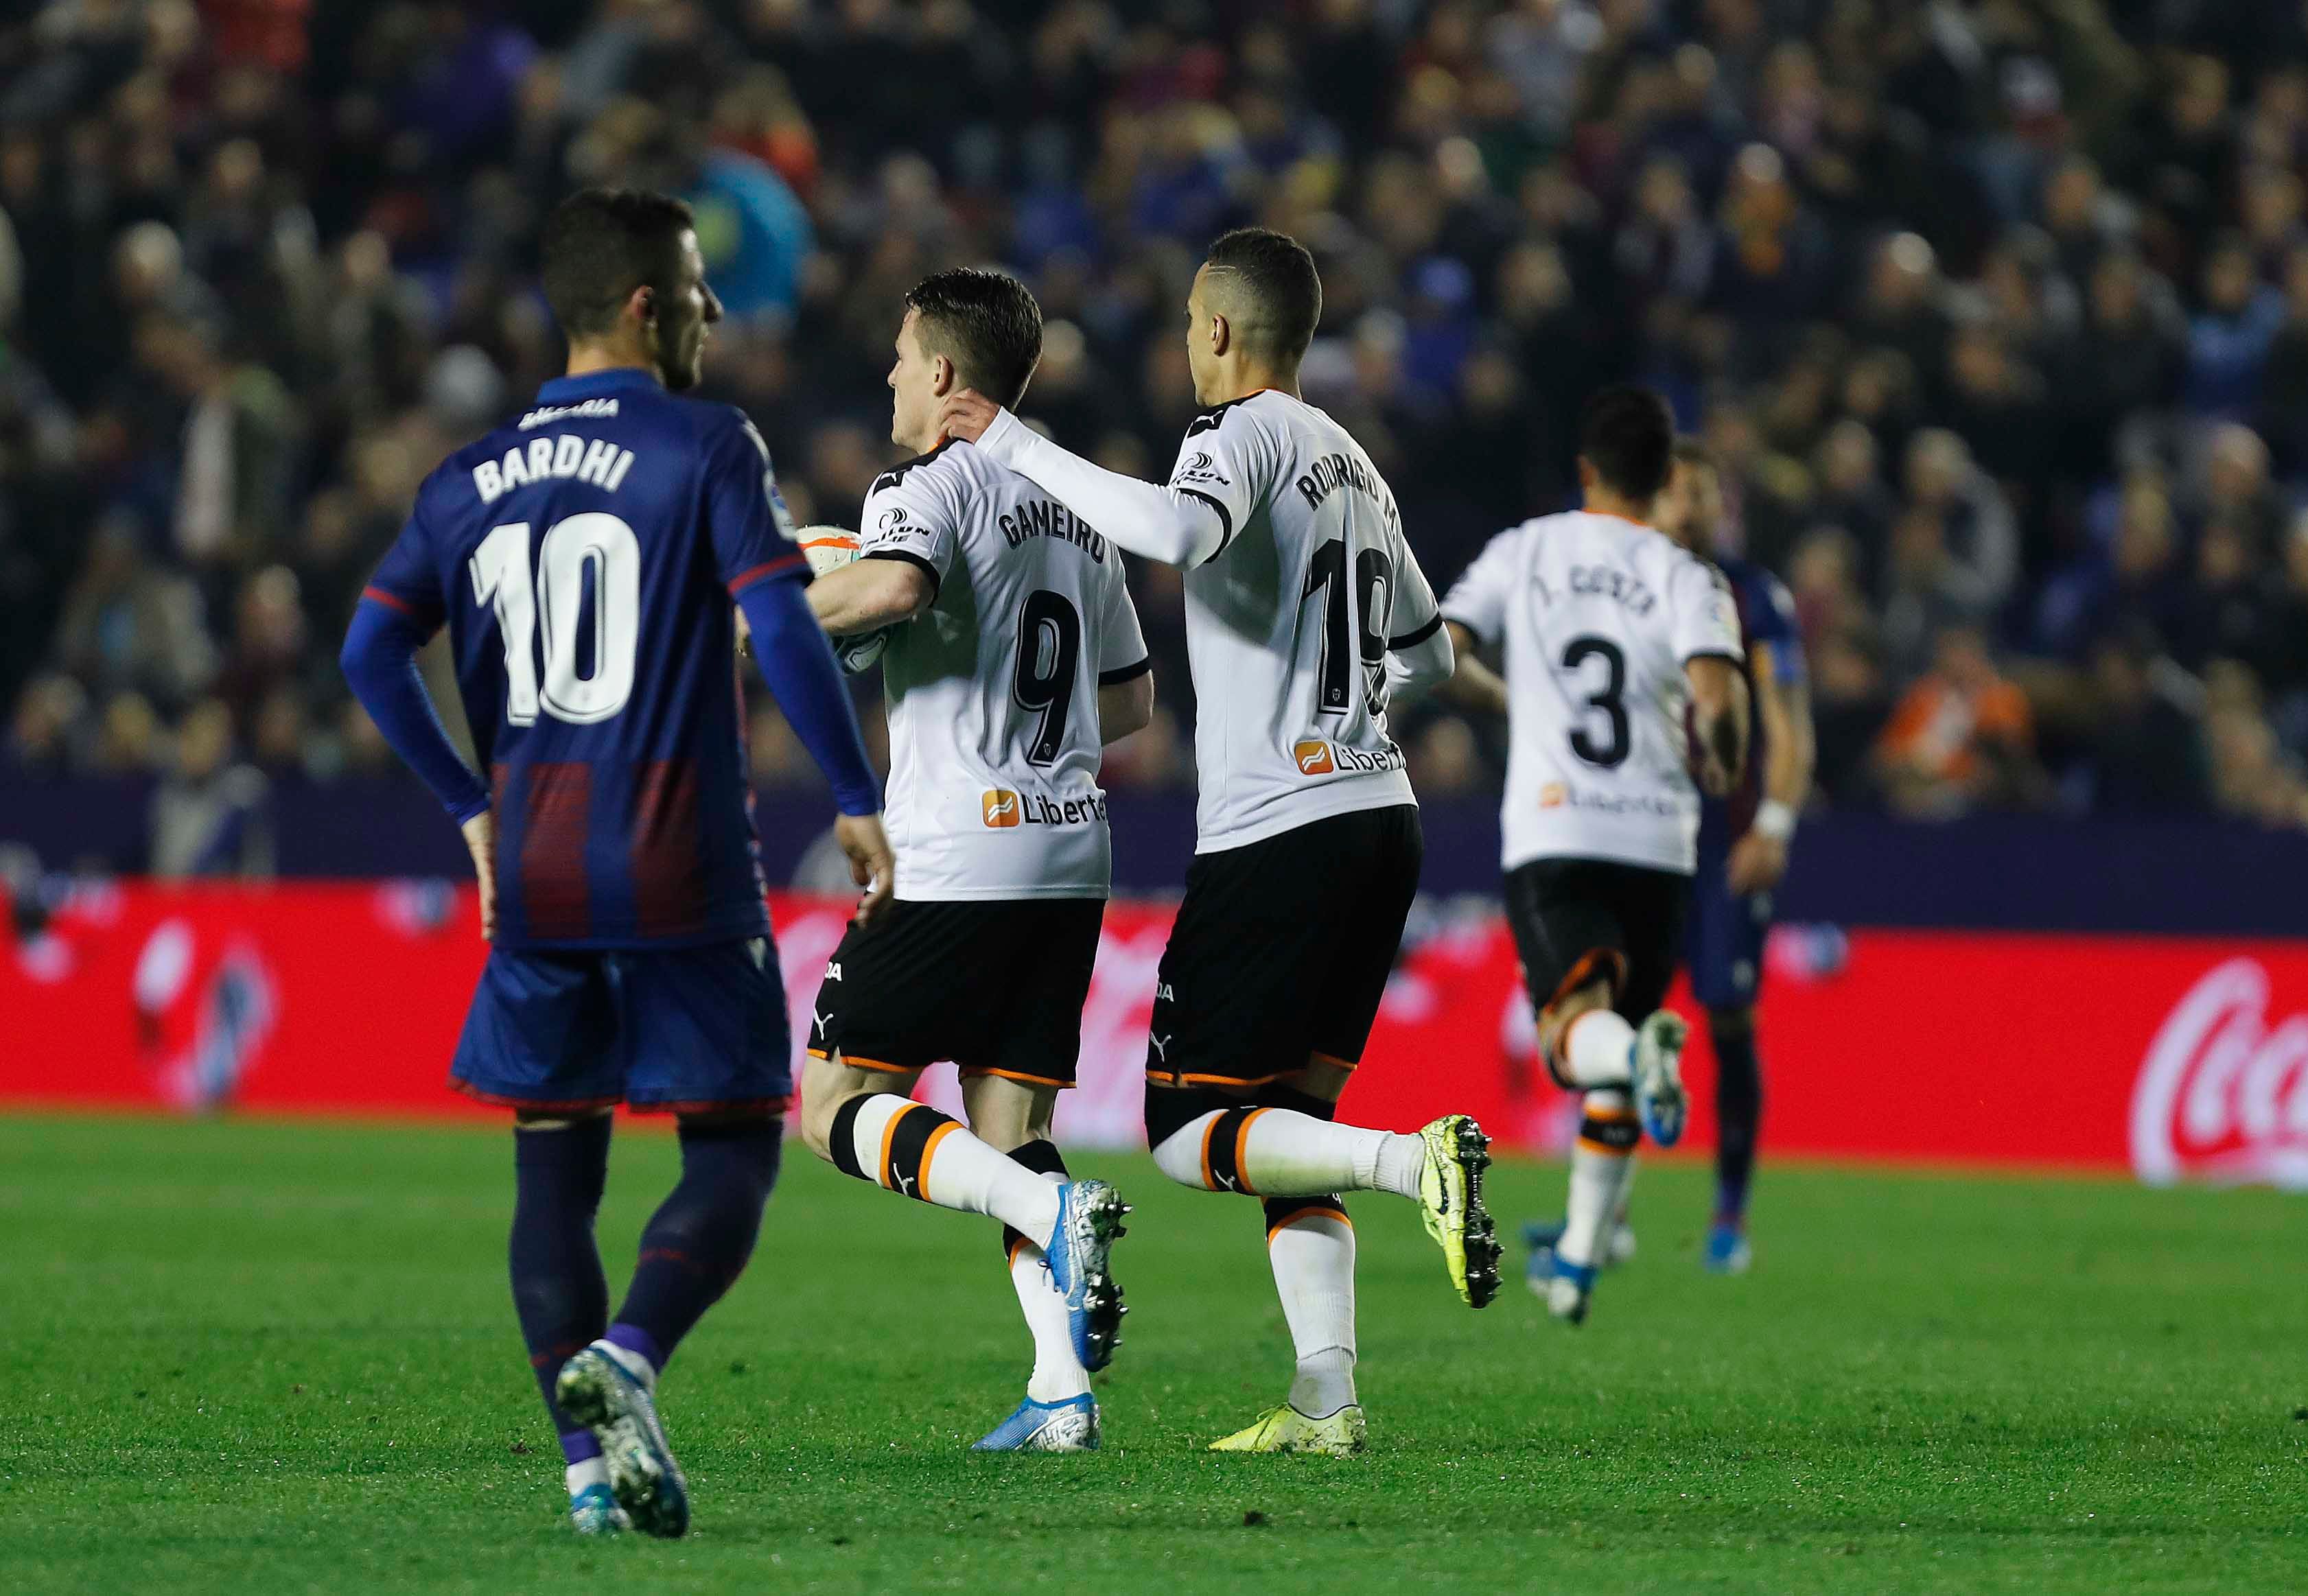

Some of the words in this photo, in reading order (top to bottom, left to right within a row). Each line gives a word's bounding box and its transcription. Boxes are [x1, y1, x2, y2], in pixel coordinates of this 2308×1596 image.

[471, 434, 636, 505] BARDHI
[1296, 453, 1379, 511] RODRIGO
[999, 500, 1106, 565] GAMEIRO
[469, 511, 641, 727] 10
[1301, 538, 1394, 716] 19
[1012, 589, 1080, 768] 9
[1562, 632, 1631, 769] 3
[1332, 742, 1406, 771] Libert
